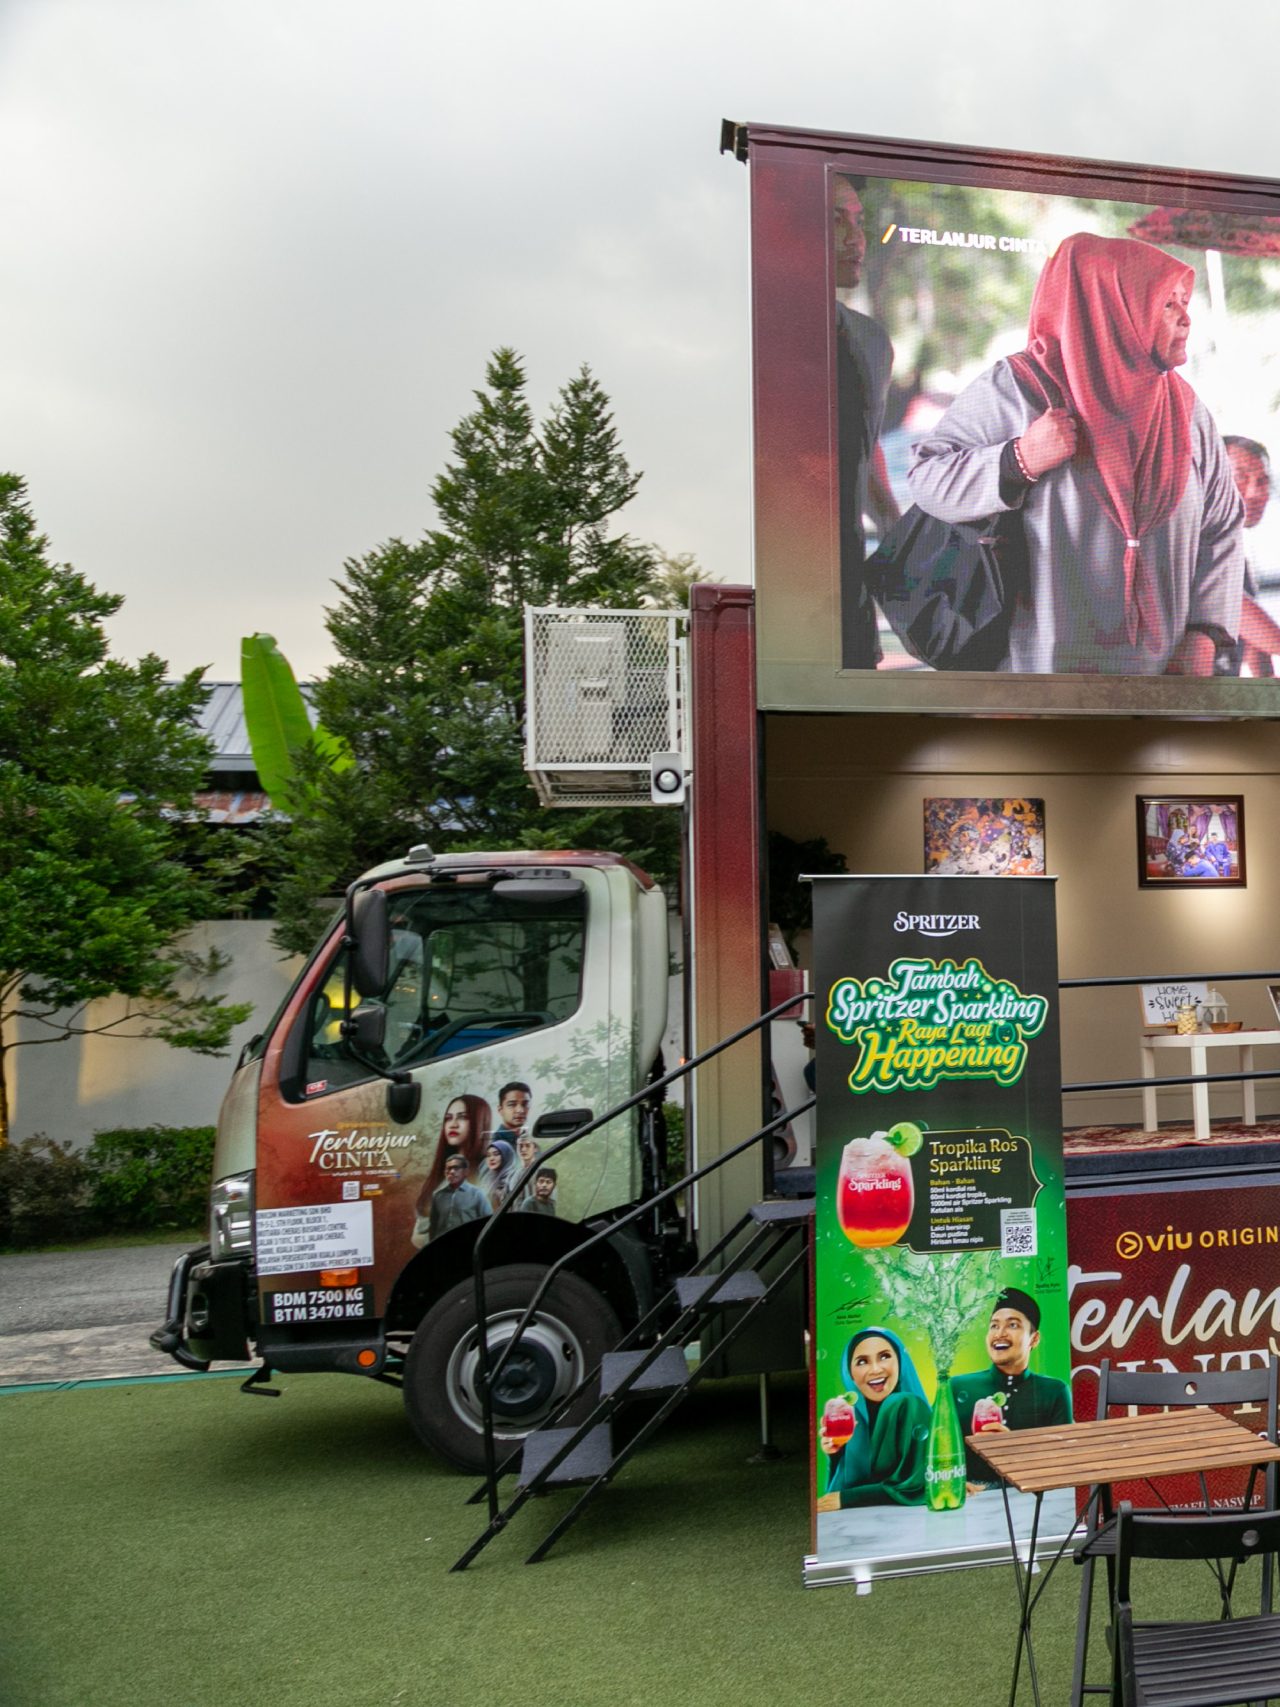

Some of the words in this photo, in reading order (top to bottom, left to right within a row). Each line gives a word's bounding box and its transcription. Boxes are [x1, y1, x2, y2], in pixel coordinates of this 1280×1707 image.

[899, 227, 996, 250] TERLANJUR
[999, 236, 1048, 253] CINTA
[893, 911, 981, 932] SPRITZER
[896, 962, 980, 999] Tambah
[1157, 984, 1188, 995] HOME
[834, 984, 935, 1031] Spritzer
[934, 990, 1041, 1027] Sparkling
[898, 1019, 947, 1046] Raya
[950, 1021, 992, 1046] Lagi
[857, 1031, 1020, 1080] Happening
[308, 1129, 417, 1163] Terlanjur
[929, 1139, 987, 1158] Tropika
[990, 1138, 1018, 1153] Ros
[319, 1151, 394, 1170] CINTA
[929, 1156, 1003, 1176] Sparkling
[848, 1177, 902, 1192] Sparkling
[1146, 1226, 1192, 1251] viu
[273, 1292, 306, 1307] BDM
[308, 1289, 343, 1304] 7500
[345, 1287, 364, 1301] KG
[274, 1307, 307, 1322] BTM
[309, 1305, 344, 1320] 3470
[345, 1303, 364, 1317] KG
